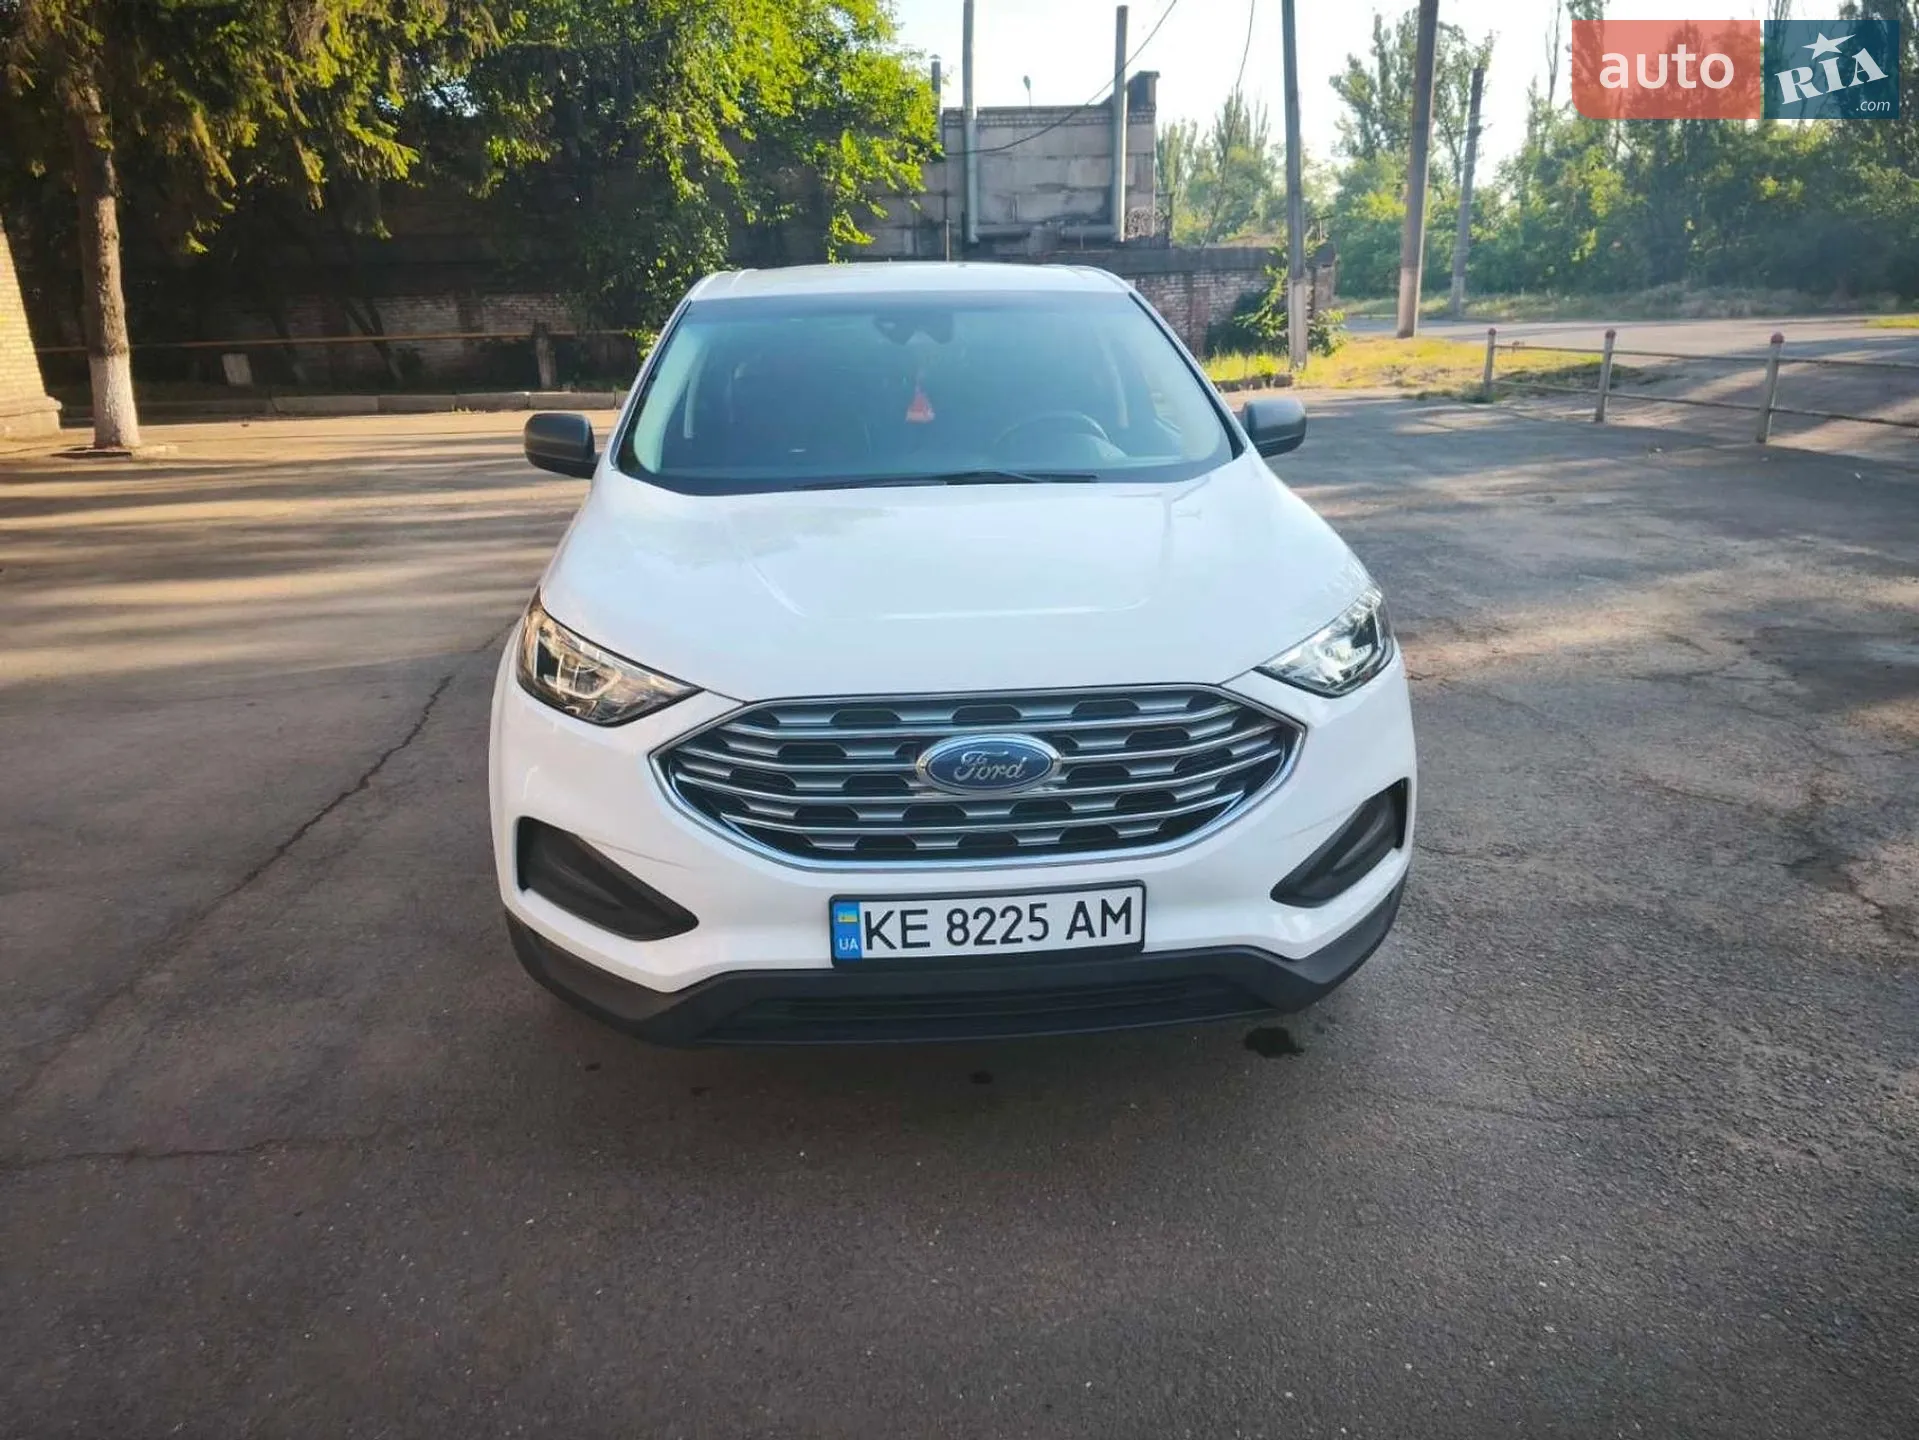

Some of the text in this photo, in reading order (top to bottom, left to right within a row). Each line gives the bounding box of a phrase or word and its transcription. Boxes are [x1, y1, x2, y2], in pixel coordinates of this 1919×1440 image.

[953, 750, 1028, 782] Ford
[864, 896, 1132, 950] KE 8225 AM
[838, 938, 859, 951] UA
